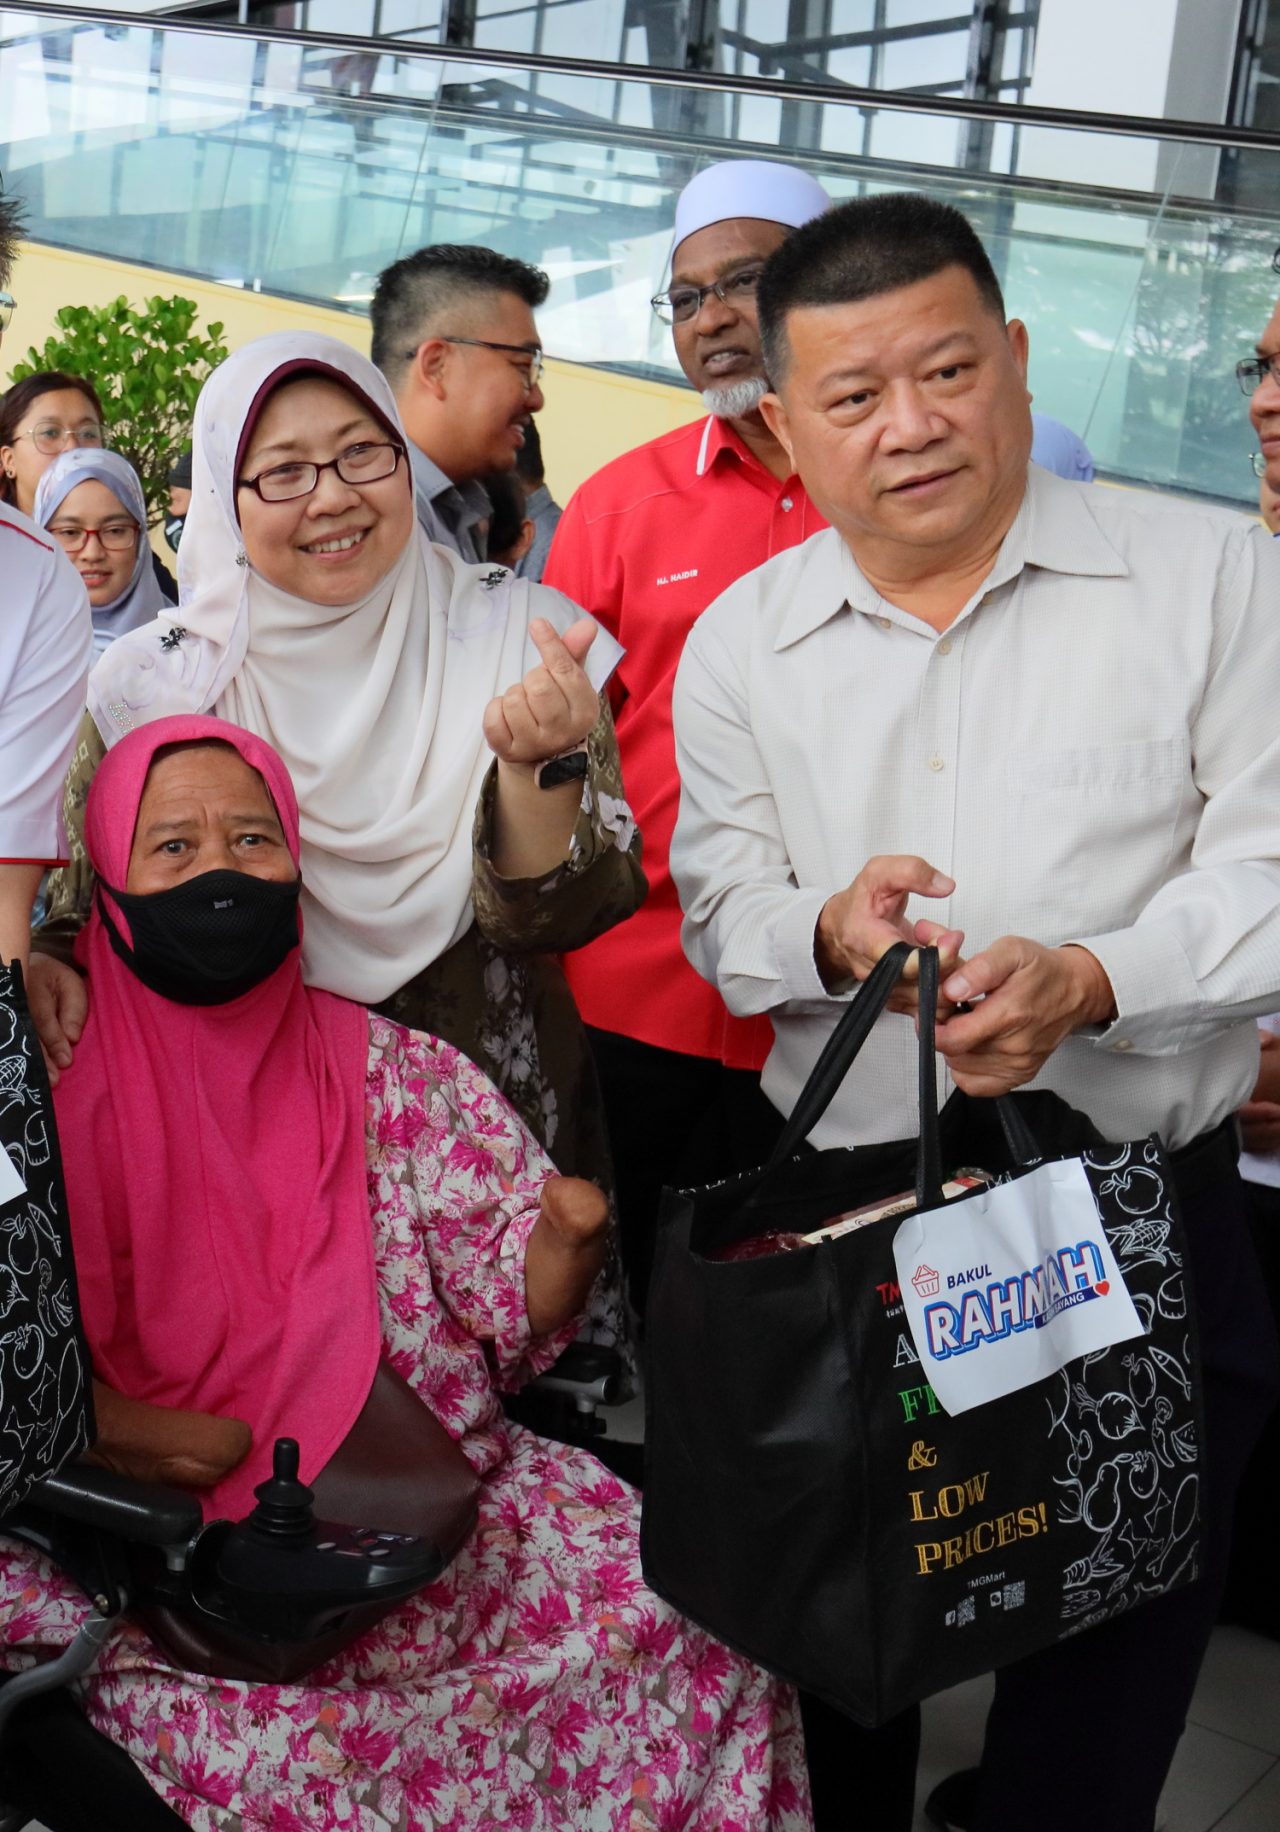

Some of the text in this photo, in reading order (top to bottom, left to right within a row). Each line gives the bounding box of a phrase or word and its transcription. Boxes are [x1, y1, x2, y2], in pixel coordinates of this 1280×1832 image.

[947, 1264, 992, 1289] BAKUL
[908, 1440, 937, 1471] &
[908, 1472, 990, 1522] LOW
[915, 1502, 1048, 1575] PRICES!
